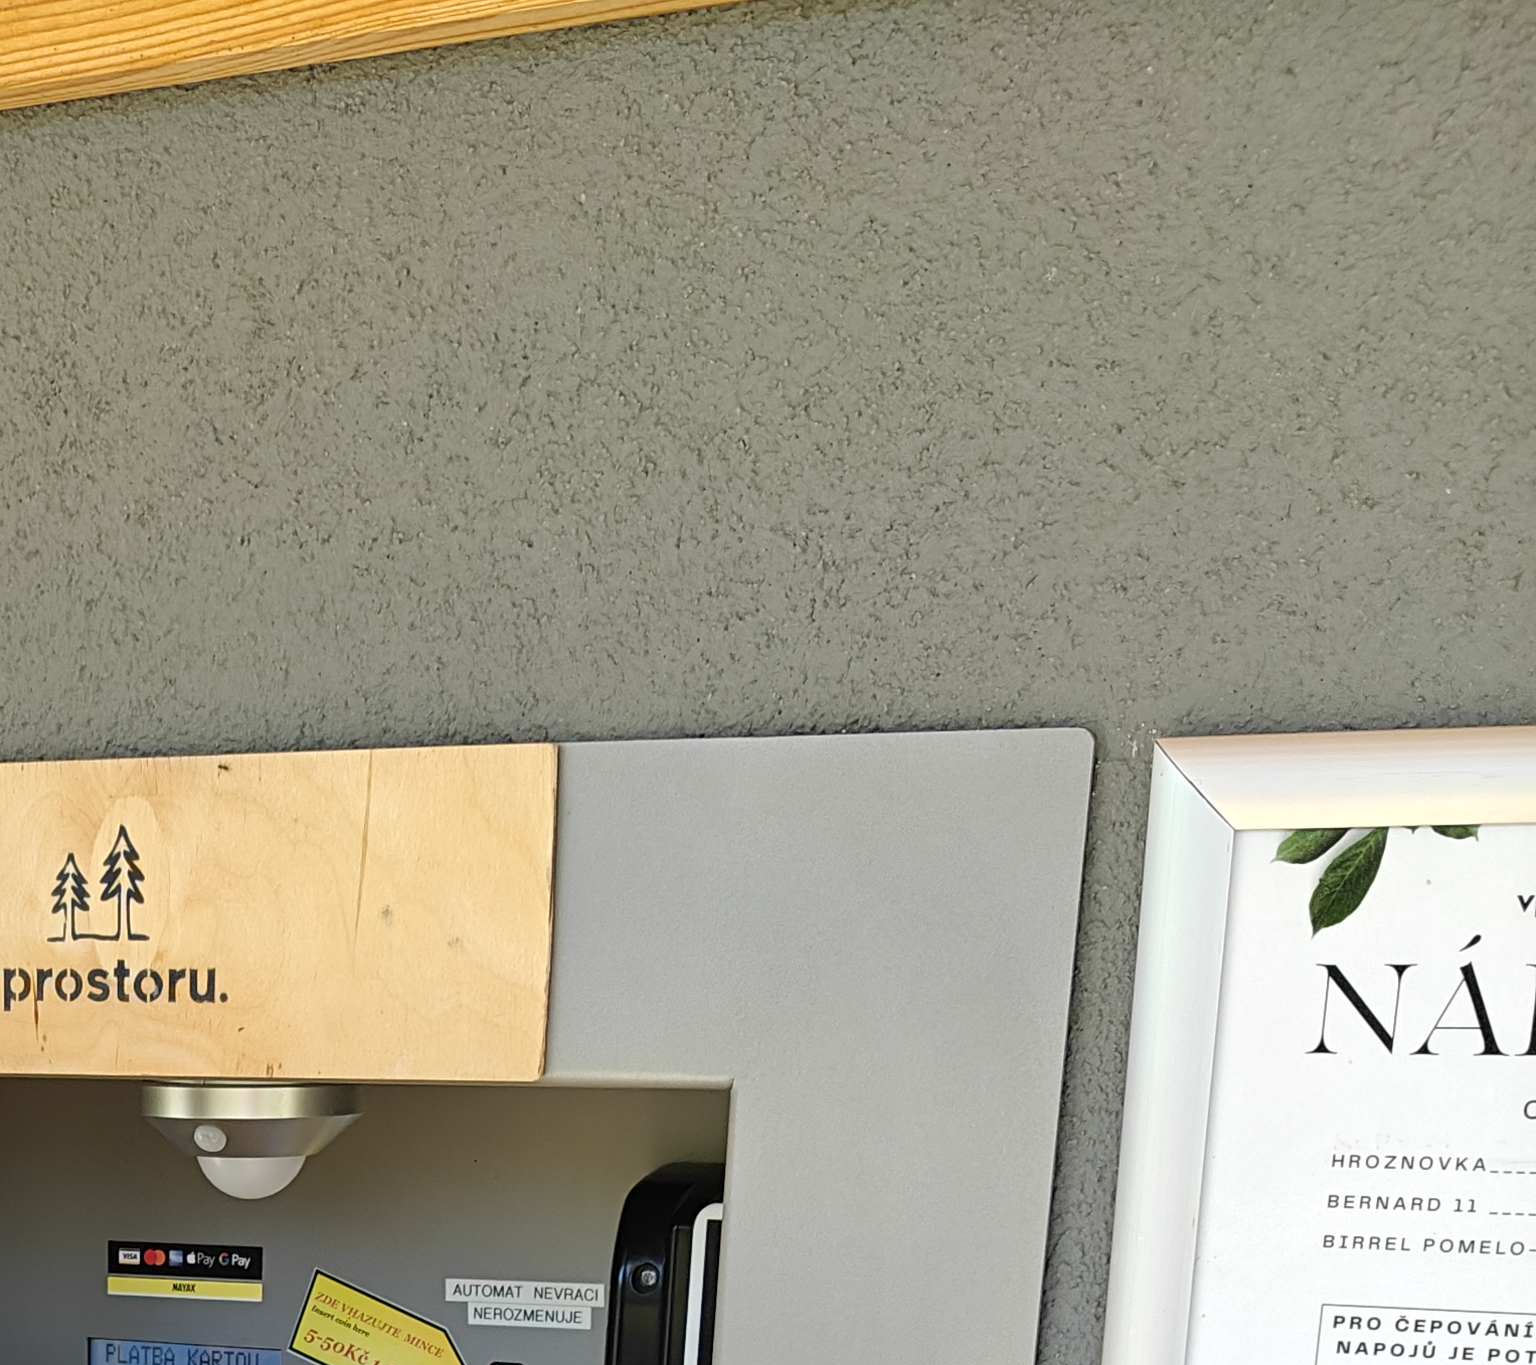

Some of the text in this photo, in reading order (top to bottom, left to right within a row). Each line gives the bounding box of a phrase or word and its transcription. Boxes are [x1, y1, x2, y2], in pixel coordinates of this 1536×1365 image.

[1327, 1194, 1477, 1213] BERNARD 11
[1323, 1234, 1411, 1251] BIRREL
[122, 1252, 138, 1260] VISA
[197, 1253, 215, 1268] Pay
[231, 1254, 251, 1270] Pay
[172, 1283, 196, 1293] NAYAX
[452, 1283, 599, 1302] AUTOMAT NEVRACI
[311, 1305, 370, 1338] Insert coin here
[473, 1307, 582, 1324] NEROZMENUJE
[314, 1291, 445, 1359] ZDE VHAZUJTE MINCE
[1333, 1315, 1535, 1339] PRO ČEPOVÁNÍ
[303, 1328, 371, 1365] 5-50Kč
[1448, 1346, 1475, 1361] JE
